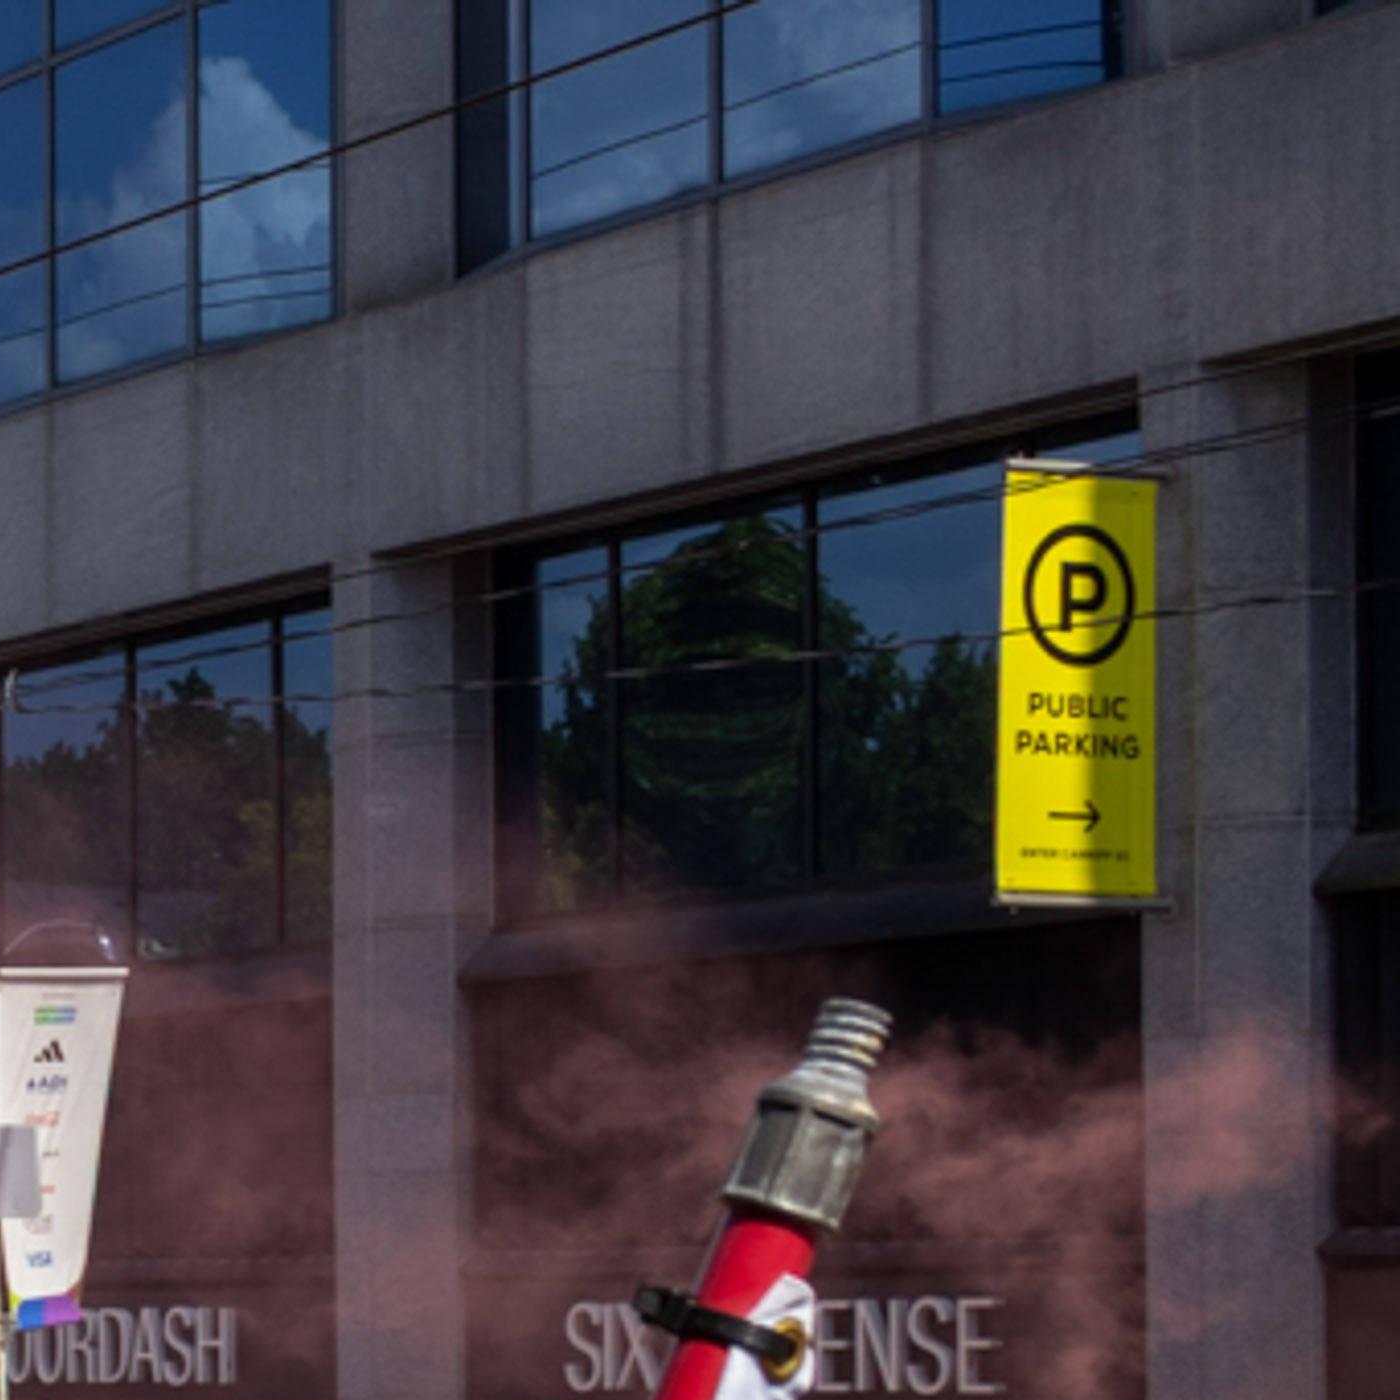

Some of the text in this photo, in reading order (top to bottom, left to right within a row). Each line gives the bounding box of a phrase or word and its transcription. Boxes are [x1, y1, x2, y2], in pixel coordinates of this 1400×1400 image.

[1058, 561, 1108, 632] P
[1027, 692, 1130, 721] PUBLIC
[1014, 729, 1141, 760] PARKING
[7, 1306, 237, 1387] OORDASH
[563, 1296, 1007, 1395] SIX ENSE
